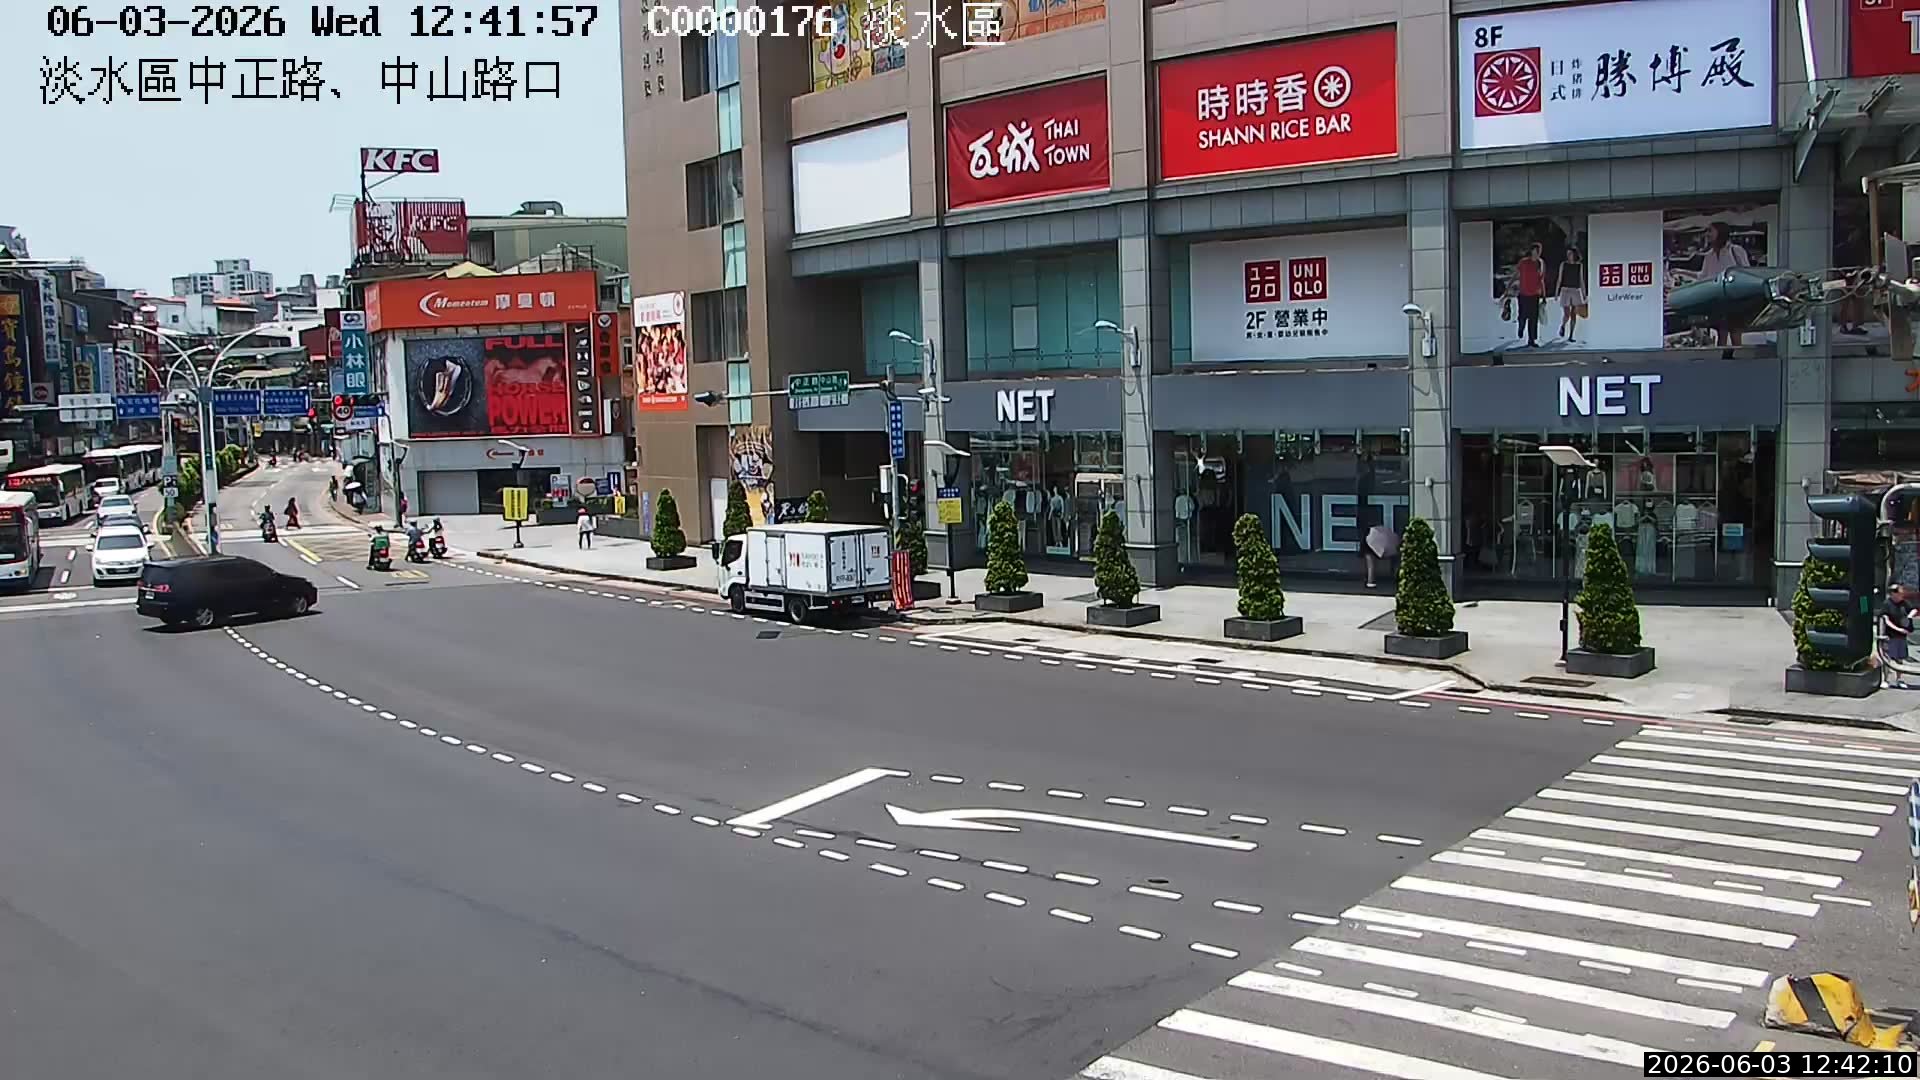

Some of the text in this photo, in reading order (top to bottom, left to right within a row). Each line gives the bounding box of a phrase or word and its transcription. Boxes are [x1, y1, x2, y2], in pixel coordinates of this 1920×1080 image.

[1474, 25, 1503, 48] 8F
[1591, 37, 1755, 101] 勝博殿
[1197, 72, 1308, 121] 時時香
[1043, 117, 1079, 140] THAI
[1198, 113, 1351, 150] SHANN RICE BAR
[363, 149, 435, 171] KFC
[968, 120, 1041, 179] 瓦城
[1043, 143, 1090, 167] TOWN
[1293, 263, 1320, 278] UNI
[1293, 279, 1323, 298] QLO
[1246, 306, 1328, 330] 2F 營業中
[485, 335, 564, 351] FULL
[344, 333, 367, 396] 小林眼
[487, 395, 567, 427] POWER
[997, 388, 1055, 422] NET
[1559, 374, 1661, 416] NET
[1271, 493, 1409, 552] NET
